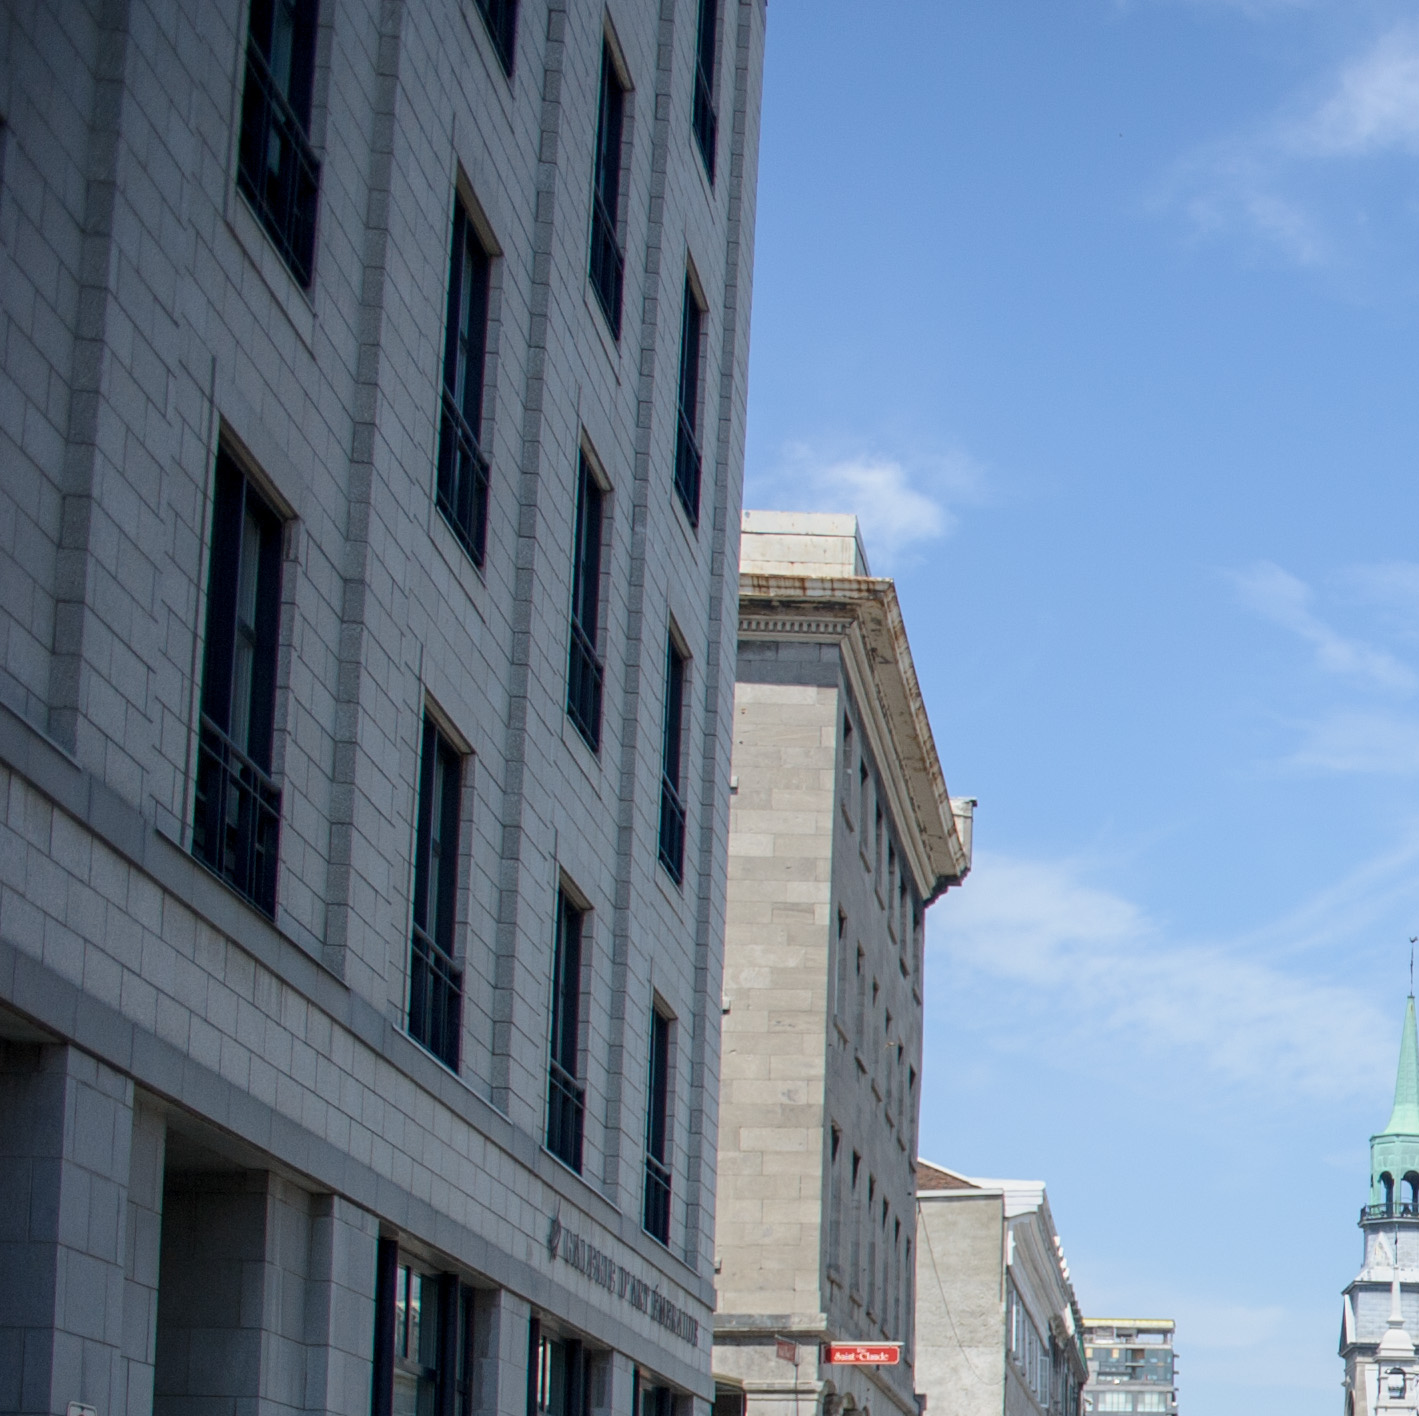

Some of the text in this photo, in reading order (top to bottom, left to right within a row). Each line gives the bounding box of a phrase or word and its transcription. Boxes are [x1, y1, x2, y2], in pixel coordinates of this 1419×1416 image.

[563, 1227, 699, 1347] GALERIE D'ART ÉMERAUDE
